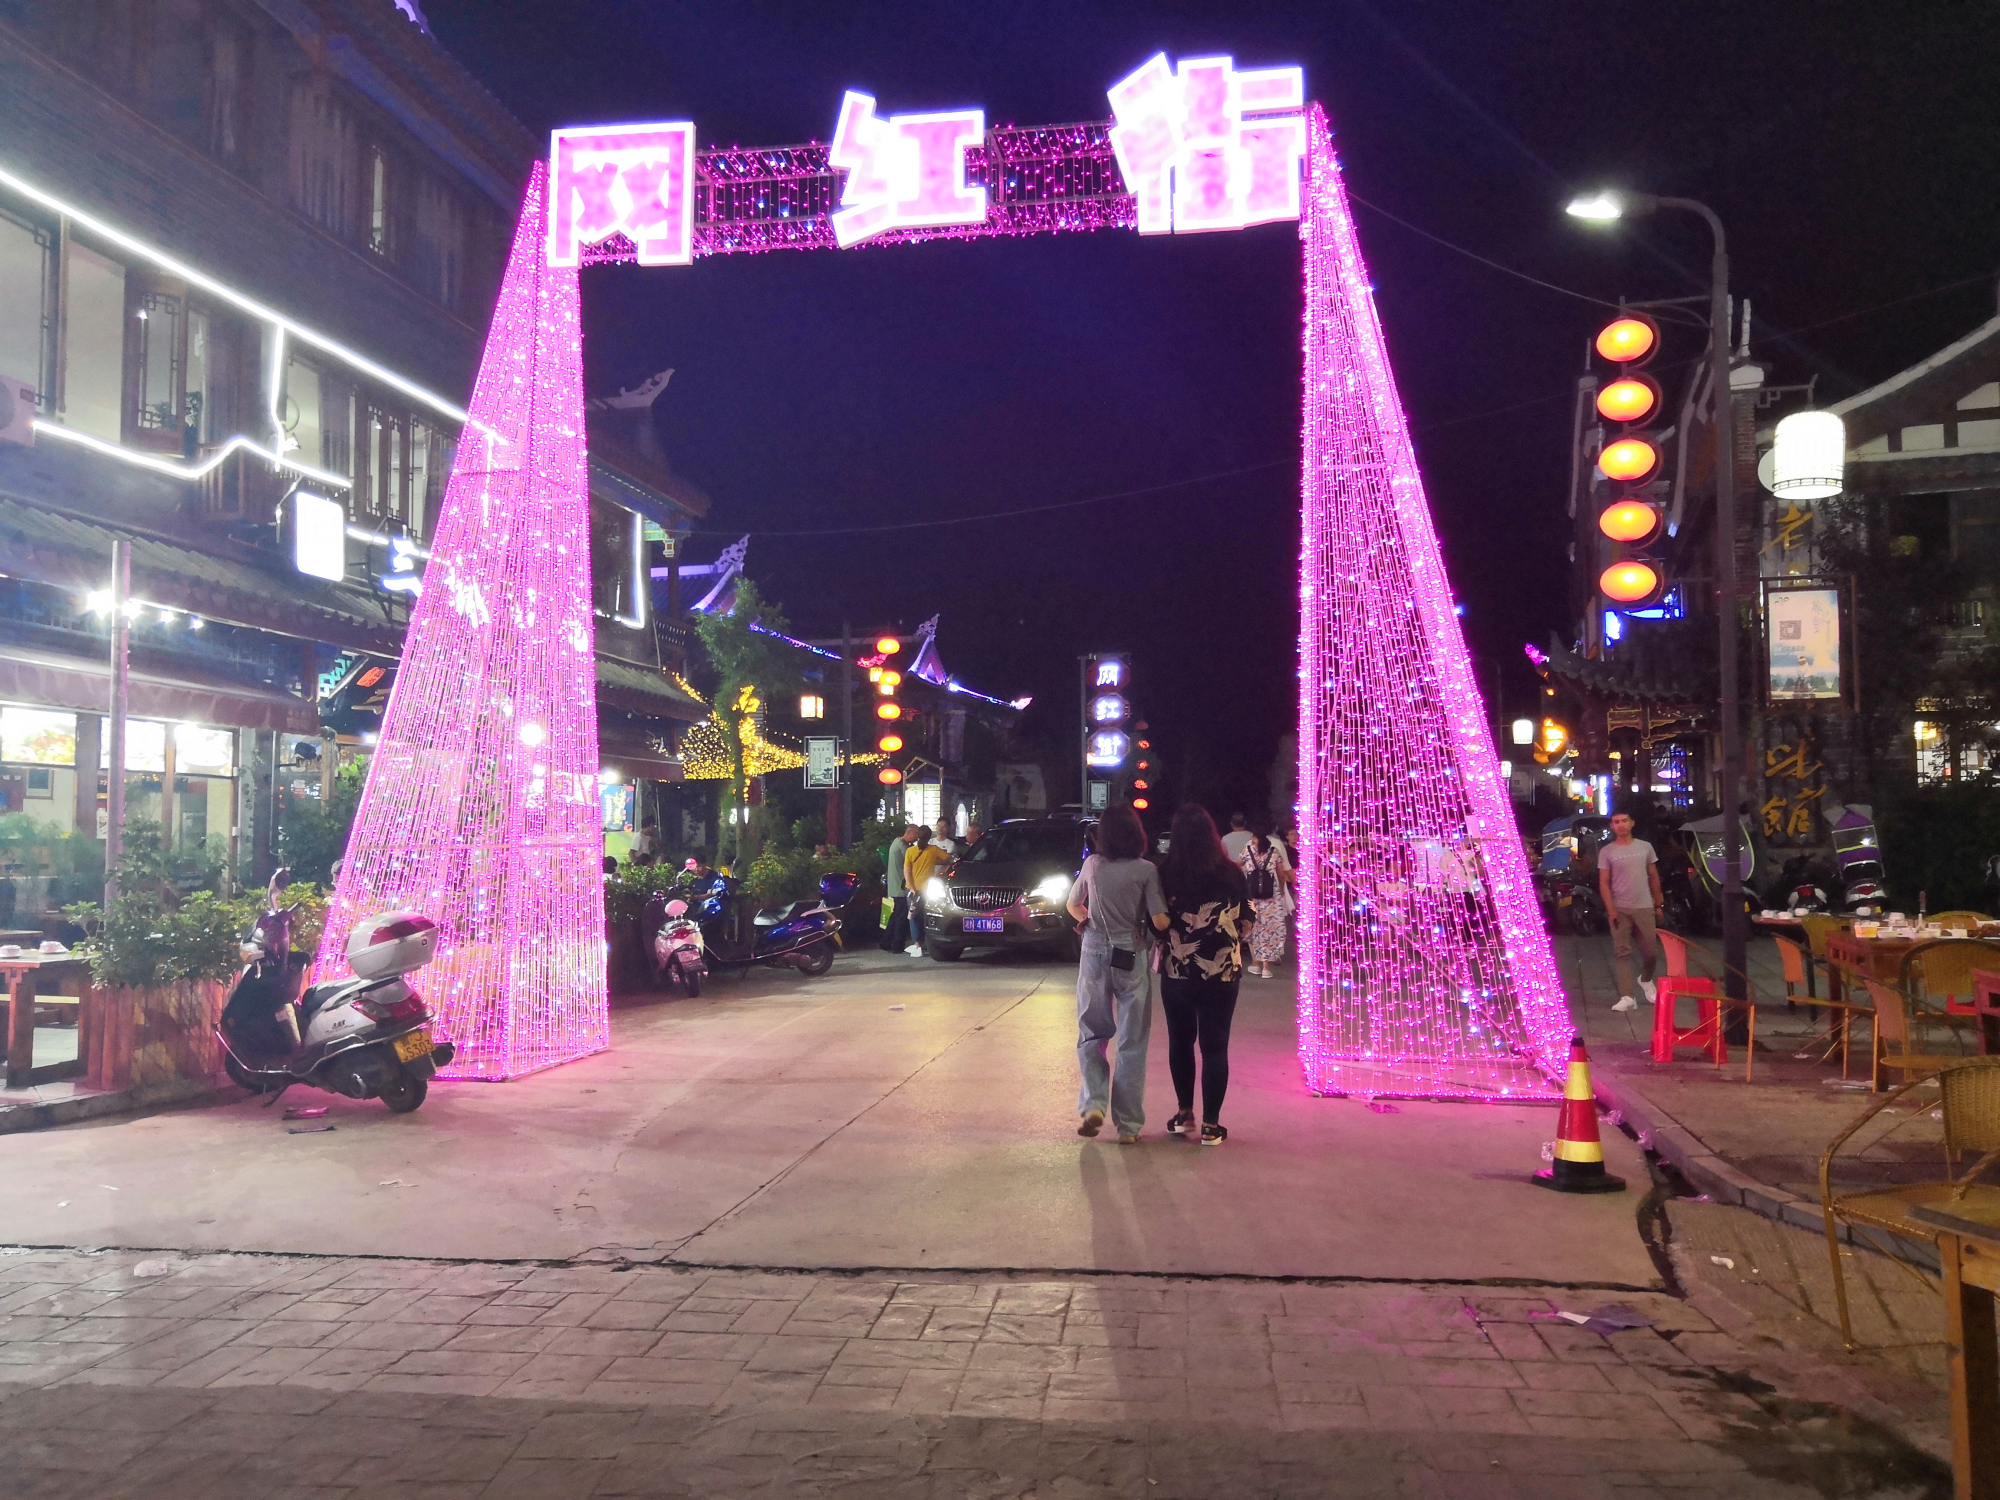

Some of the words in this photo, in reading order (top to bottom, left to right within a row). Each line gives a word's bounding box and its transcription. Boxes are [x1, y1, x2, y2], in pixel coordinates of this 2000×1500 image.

[545, 52, 1307, 268] 网红街
[1095, 662, 1122, 757] 网红街
